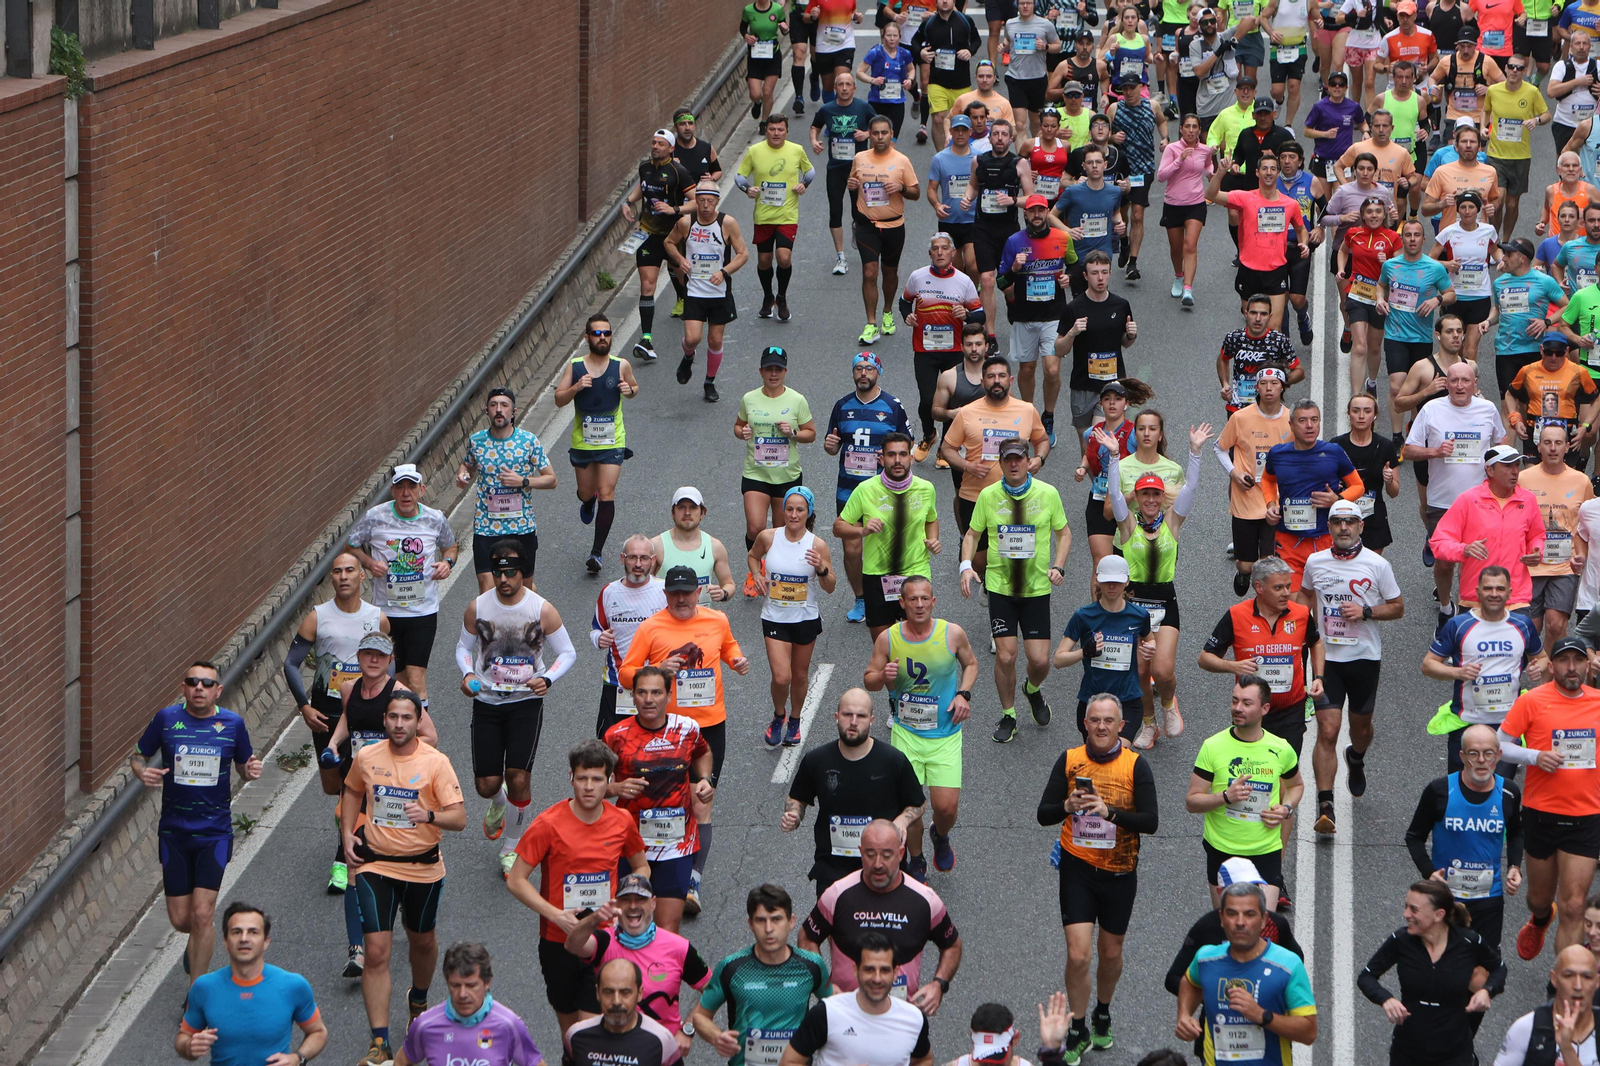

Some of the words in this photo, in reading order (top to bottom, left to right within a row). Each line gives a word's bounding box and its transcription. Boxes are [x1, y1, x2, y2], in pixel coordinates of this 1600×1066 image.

[1235, 350, 1266, 362] CORRE
[402, 537, 424, 555] 30
[1334, 594, 1352, 602] SATO
[1255, 644, 1266, 654] CA
[1266, 643, 1292, 653] GERENA
[1476, 641, 1513, 652] OTIS
[689, 682, 706, 690] 10037
[910, 707, 924, 715] 8547
[1236, 767, 1260, 775] WORLD
[389, 789, 414, 797] ZURICH
[386, 802, 403, 810] 8270
[1085, 821, 1101, 829] 7589
[1445, 817, 1504, 834] FRANCE
[842, 830, 860, 838] 10463
[1079, 831, 1106, 839] SALVATORE
[579, 873, 606, 882] ZURICH
[579, 889, 597, 897] 9039
[764, 1031, 793, 1039] ZURICH
[1228, 1031, 1247, 1039] 9122
[761, 1044, 783, 1053] 10071
[446, 1053, 491, 1066] love
